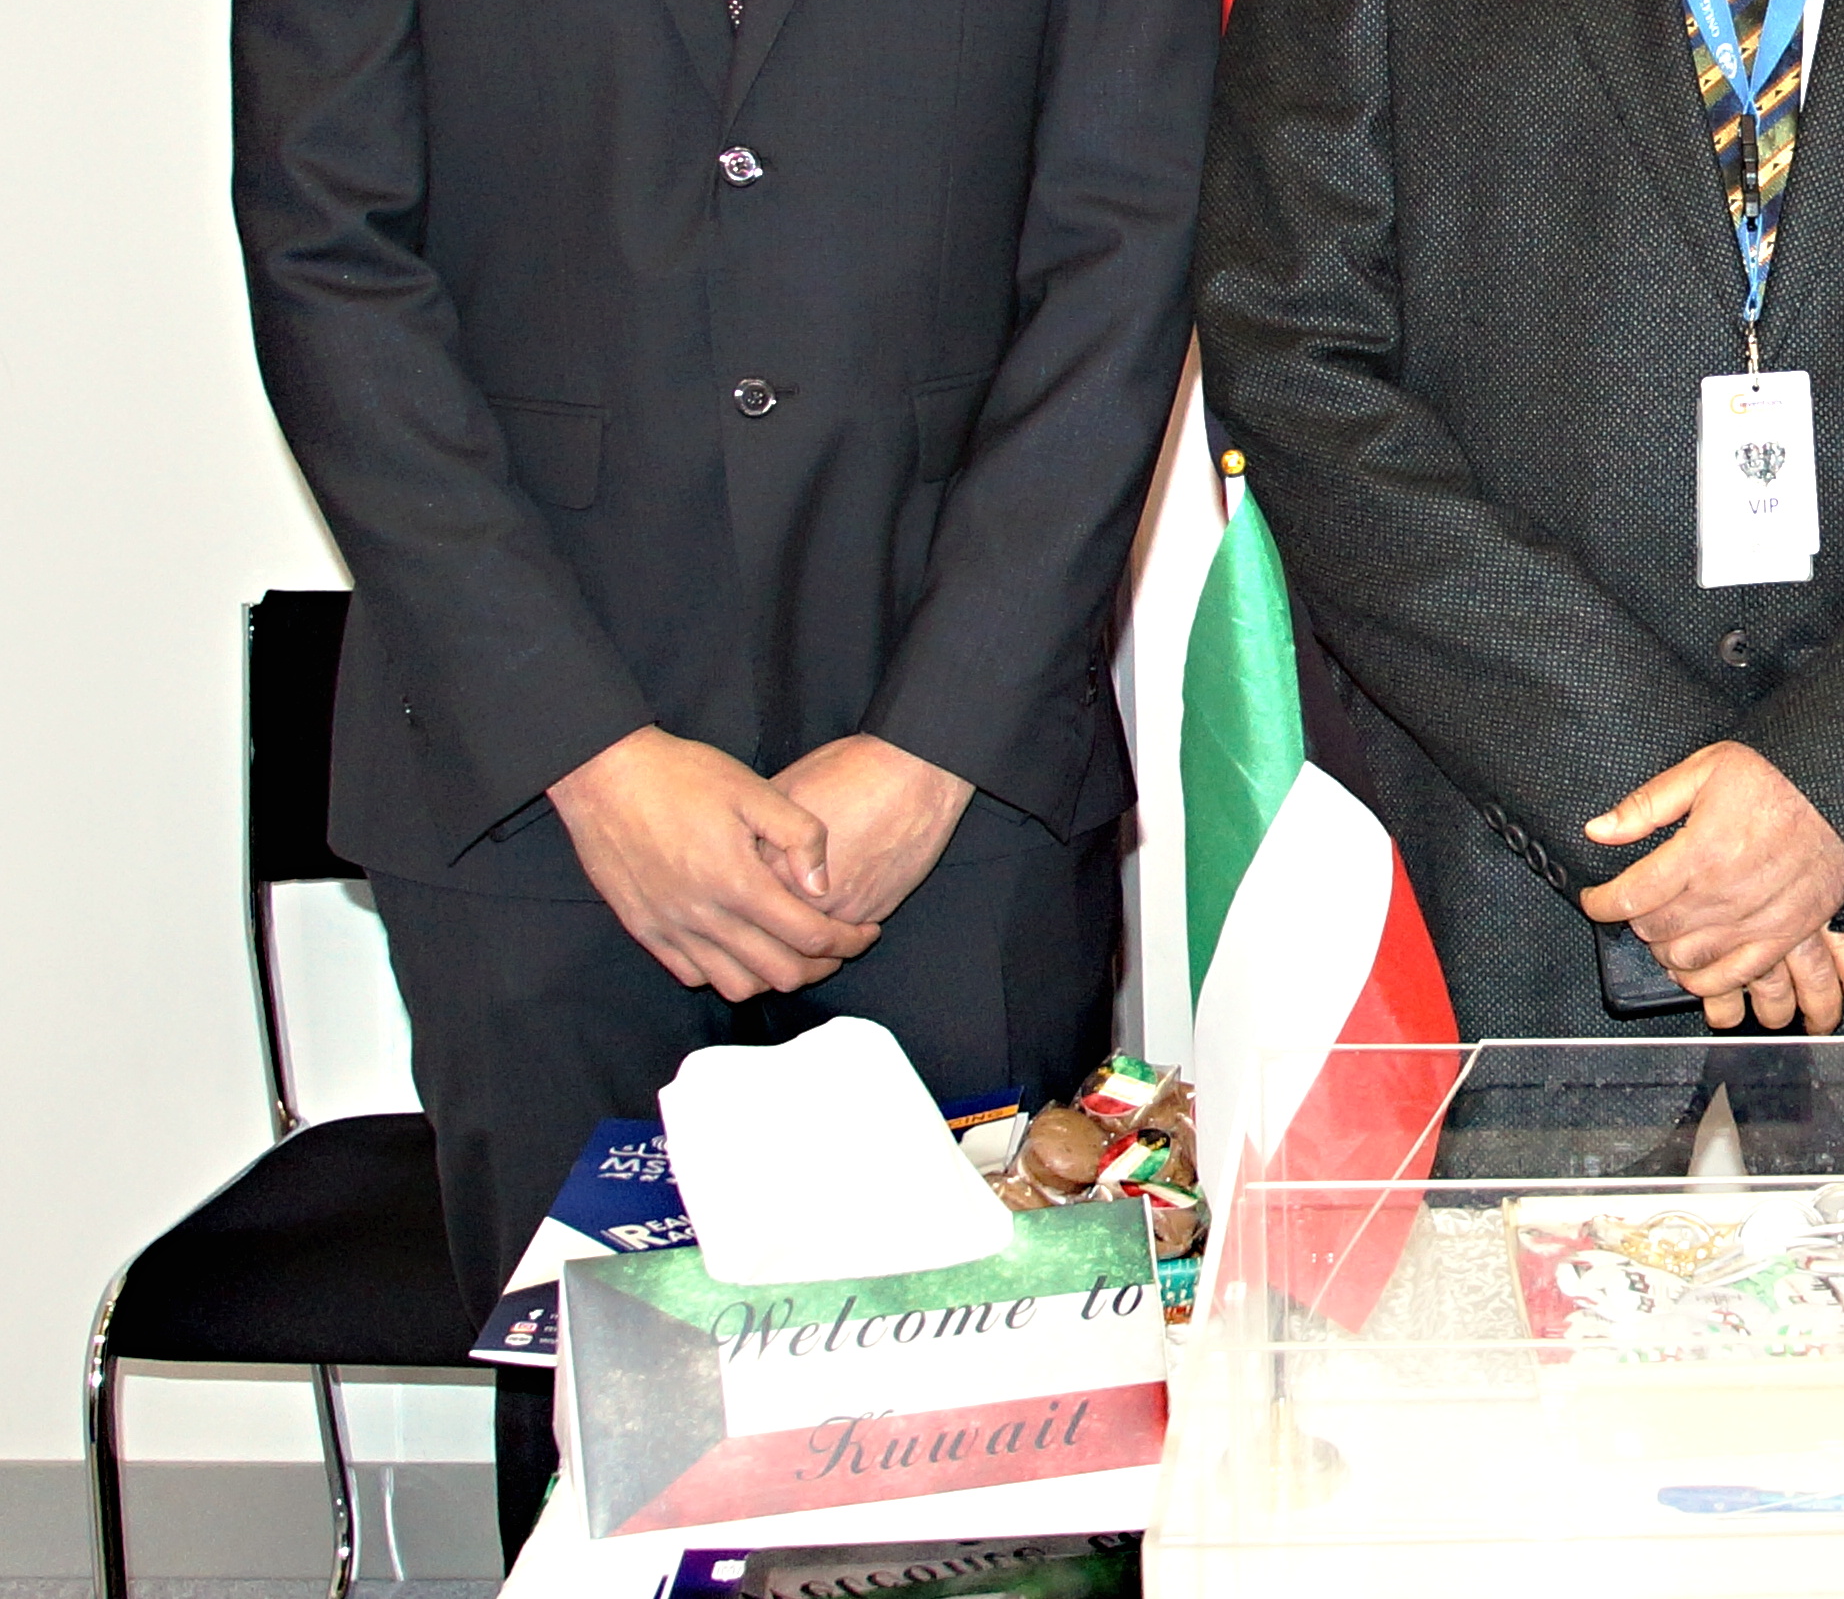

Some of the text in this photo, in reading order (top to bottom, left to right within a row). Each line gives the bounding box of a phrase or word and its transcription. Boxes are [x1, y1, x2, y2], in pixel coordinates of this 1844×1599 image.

[1748, 497, 1780, 515] VIP
[598, 1156, 667, 1174] MS
[711, 1296, 1037, 1364] Welcome
[1081, 1274, 1144, 1320] to
[796, 1400, 1090, 1482] Kuwait
